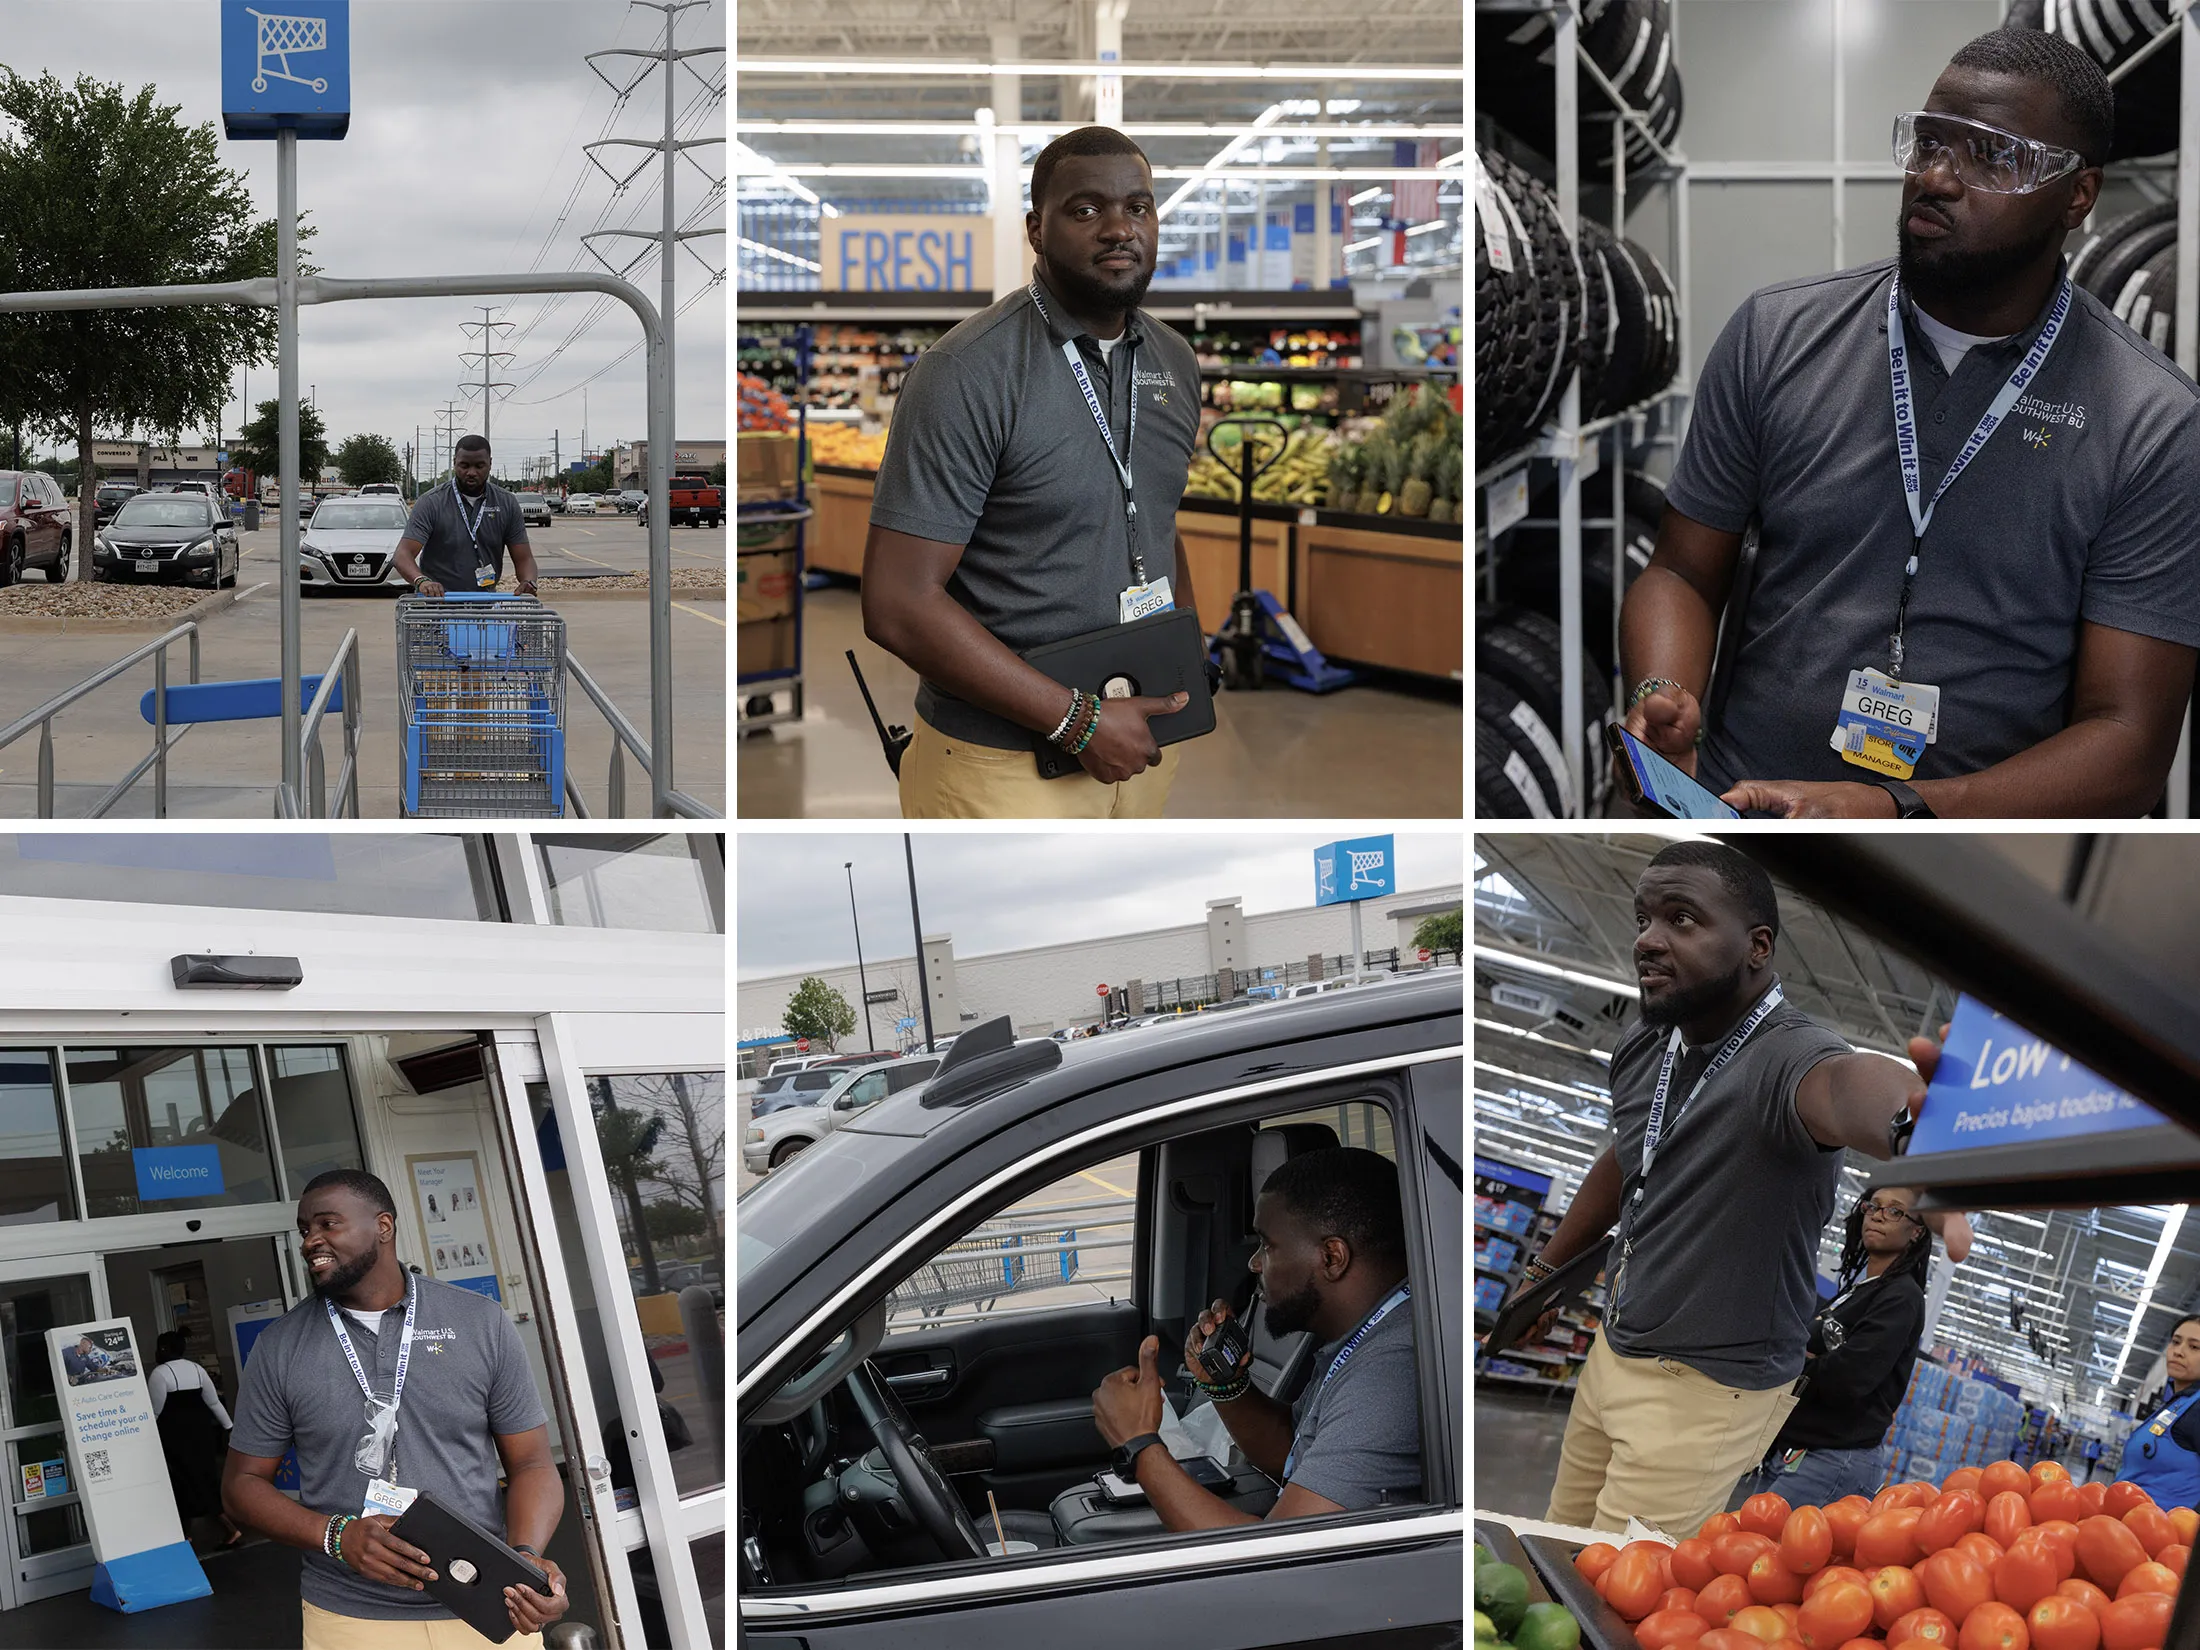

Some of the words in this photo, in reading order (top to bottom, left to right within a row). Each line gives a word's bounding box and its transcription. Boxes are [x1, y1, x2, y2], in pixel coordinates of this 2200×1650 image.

[840, 231, 973, 292] FRESH
[2049, 295, 2069, 325] Win
[2042, 322, 2058, 342] to
[1891, 346, 1904, 370] Be
[2035, 340, 2047, 357] it
[2024, 352, 2042, 372] in
[1892, 371, 1906, 387] in
[2009, 367, 2031, 389] Be
[1072, 361, 1085, 379] Be
[1079, 377, 1089, 391] in
[1090, 400, 1099, 413] to
[1095, 412, 1109, 438] Win
[1894, 391, 1909, 402] it
[1896, 401, 1910, 420] to
[2011, 403, 2067, 424] OUTHWEST
[2067, 416, 2085, 429] BU
[2020, 394, 2061, 413] almart
[2062, 402, 2086, 420] U.S.
[1978, 414, 1993, 431] YBM
[1983, 416, 2000, 434] 2024
[1898, 421, 1915, 456] Win
[1949, 447, 1971, 475] Win
[1969, 432, 1986, 450] it
[1903, 457, 1916, 471] it
[1904, 473, 1913, 494] 2024
[1911, 473, 1919, 492] YBM
[1133, 595, 1164, 618] GREG
[1857, 677, 1868, 687] 15
[1872, 685, 1905, 702] Walmart
[1858, 697, 1913, 727] GREG
[1852, 751, 1902, 771] MANAGER
[1704, 1067, 1717, 1081] Be
[1713, 1057, 1725, 1071] in
[1727, 1037, 1740, 1052] to
[1735, 1018, 1755, 1041] Win
[1751, 1010, 1762, 1025] it
[1663, 1051, 1674, 1066] Be
[1661, 1066, 1672, 1078] in
[1656, 1088, 1666, 1100] to
[1651, 1100, 1664, 1124] Win
[1953, 1107, 2010, 1134] Precios
[2010, 1099, 2057, 1131] bajos
[2057, 1089, 2116, 1118] todos
[1648, 1123, 1660, 1133] it
[149, 1165, 209, 1181] Welcome
[417, 1168, 432, 1176] Meet
[432, 1167, 446, 1175] Your
[1371, 1309, 1385, 1323] 2024
[339, 1333, 347, 1344] Be
[344, 1343, 352, 1353] in
[351, 1359, 359, 1370] to
[356, 1368, 366, 1387] Win
[1340, 1348, 1351, 1361] to
[397, 1360, 407, 1379] Win
[396, 1378, 403, 1388] to
[81, 1395, 97, 1404] Auto
[97, 1392, 113, 1401] Care
[113, 1389, 135, 1399] Center
[76, 1411, 97, 1422] Save
[98, 1407, 117, 1418] time
[119, 1404, 126, 1414] &
[78, 1418, 117, 1433] schedule
[117, 1416, 137, 1429] your
[138, 1412, 149, 1422] oil
[81, 1431, 113, 1444] change
[114, 1426, 140, 1437] online
[374, 1492, 403, 1509] GREG
